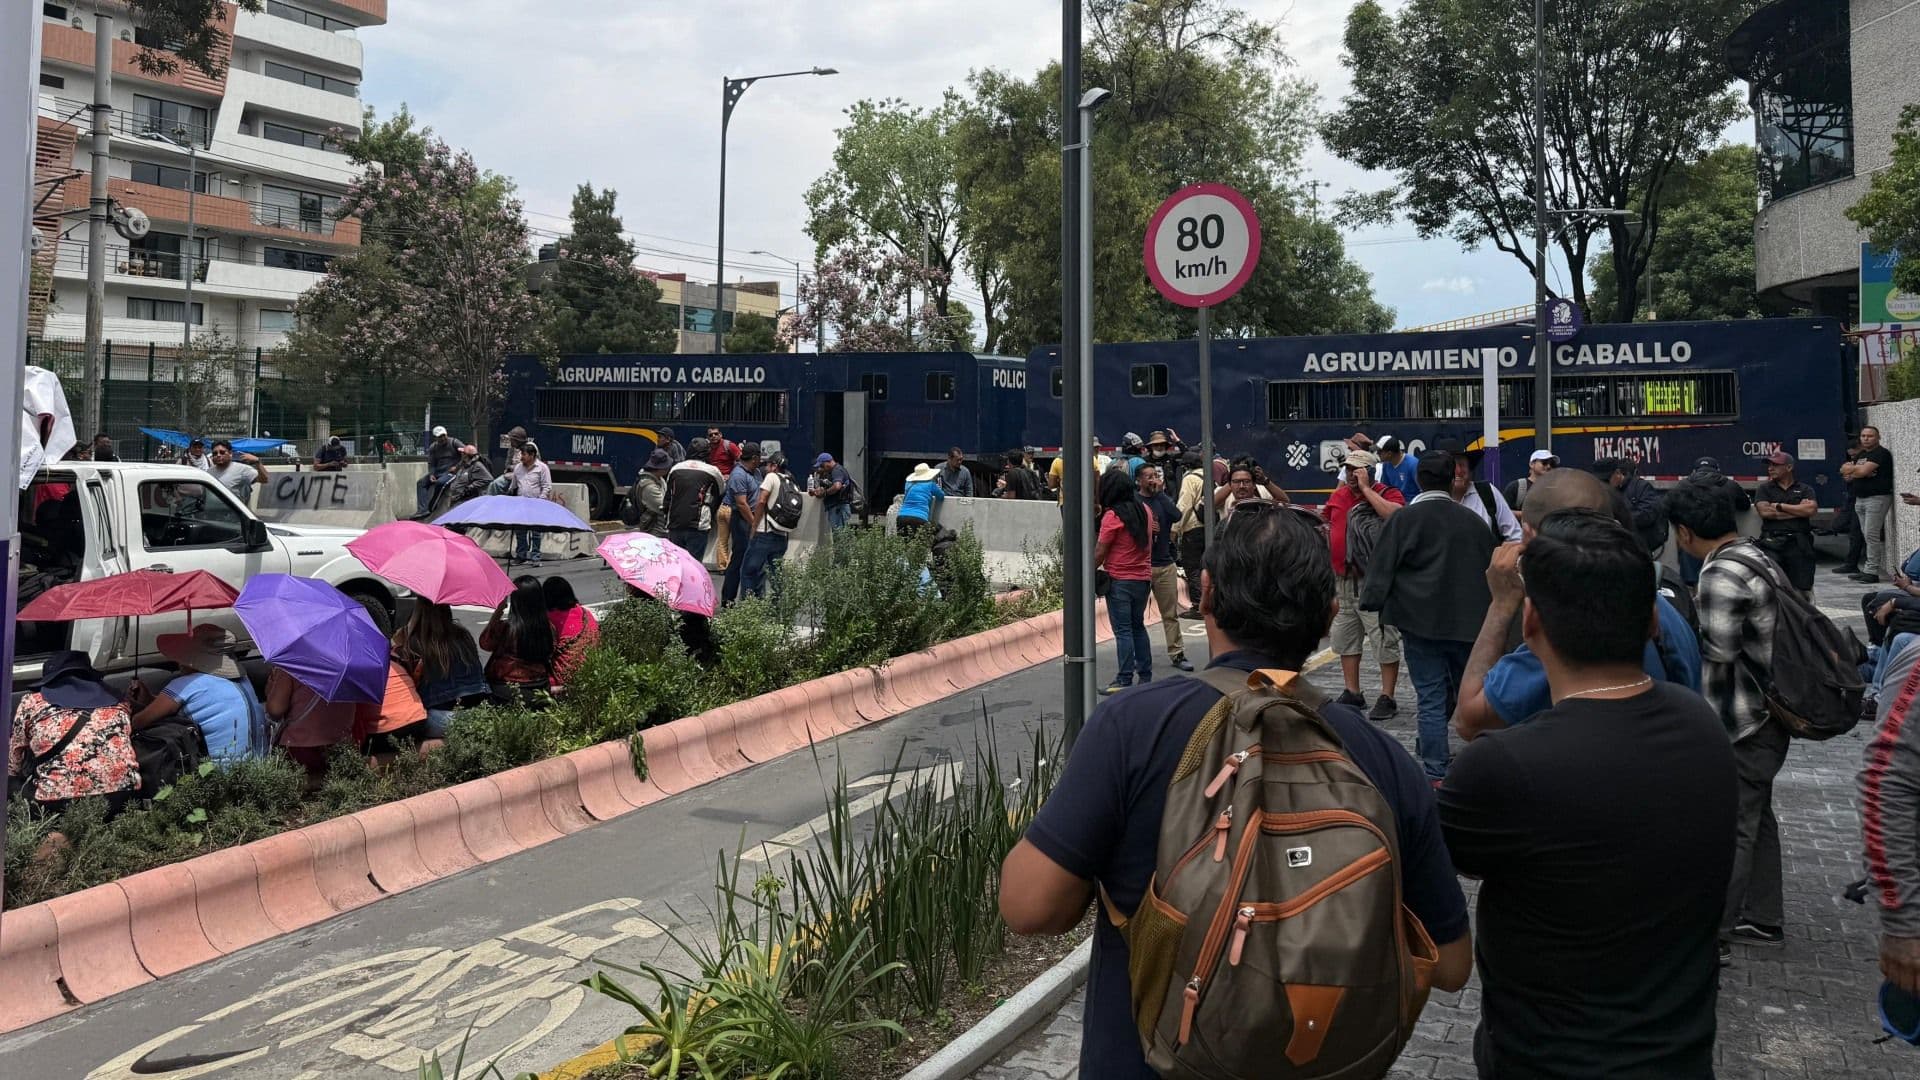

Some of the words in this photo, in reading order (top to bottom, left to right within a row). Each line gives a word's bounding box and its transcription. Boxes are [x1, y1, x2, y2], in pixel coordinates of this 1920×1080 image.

[1176, 213, 1225, 252] 80
[1175, 255, 1227, 279] km/h
[1303, 346, 1518, 373] AGRUPAMIENO
[1556, 340, 1692, 367] CABALLO
[556, 366, 672, 383] AGRUPAMIENTO
[676, 367, 688, 383] A
[691, 366, 766, 383] CABALLO
[276, 473, 348, 510] CNTE
